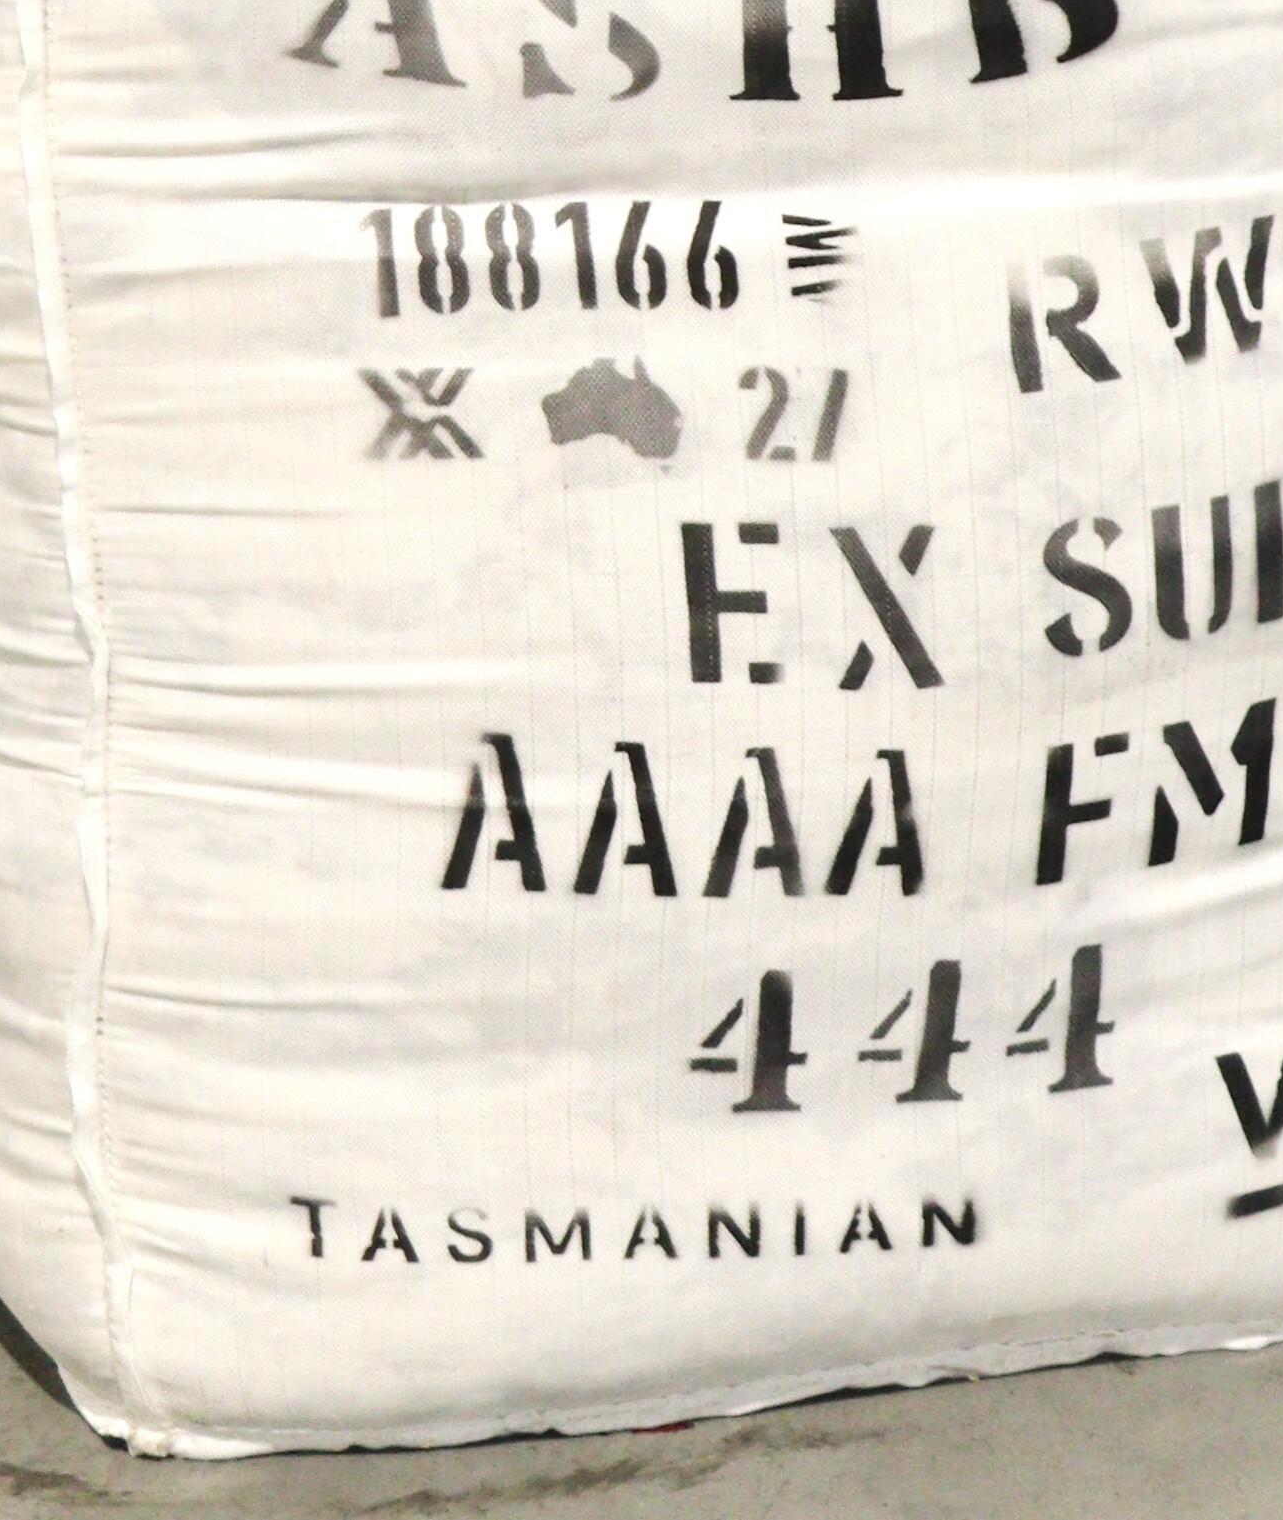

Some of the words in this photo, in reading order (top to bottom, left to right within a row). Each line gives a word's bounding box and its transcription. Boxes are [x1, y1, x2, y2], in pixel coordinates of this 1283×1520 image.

[362, 200, 741, 318] 188166
[679, 521, 945, 692] EX
[439, 732, 926, 899] AAAA
[1033, 697, 1278, 888] FM
[688, 943, 1116, 1114] 444
[289, 1196, 979, 1264] TASMANIAN
